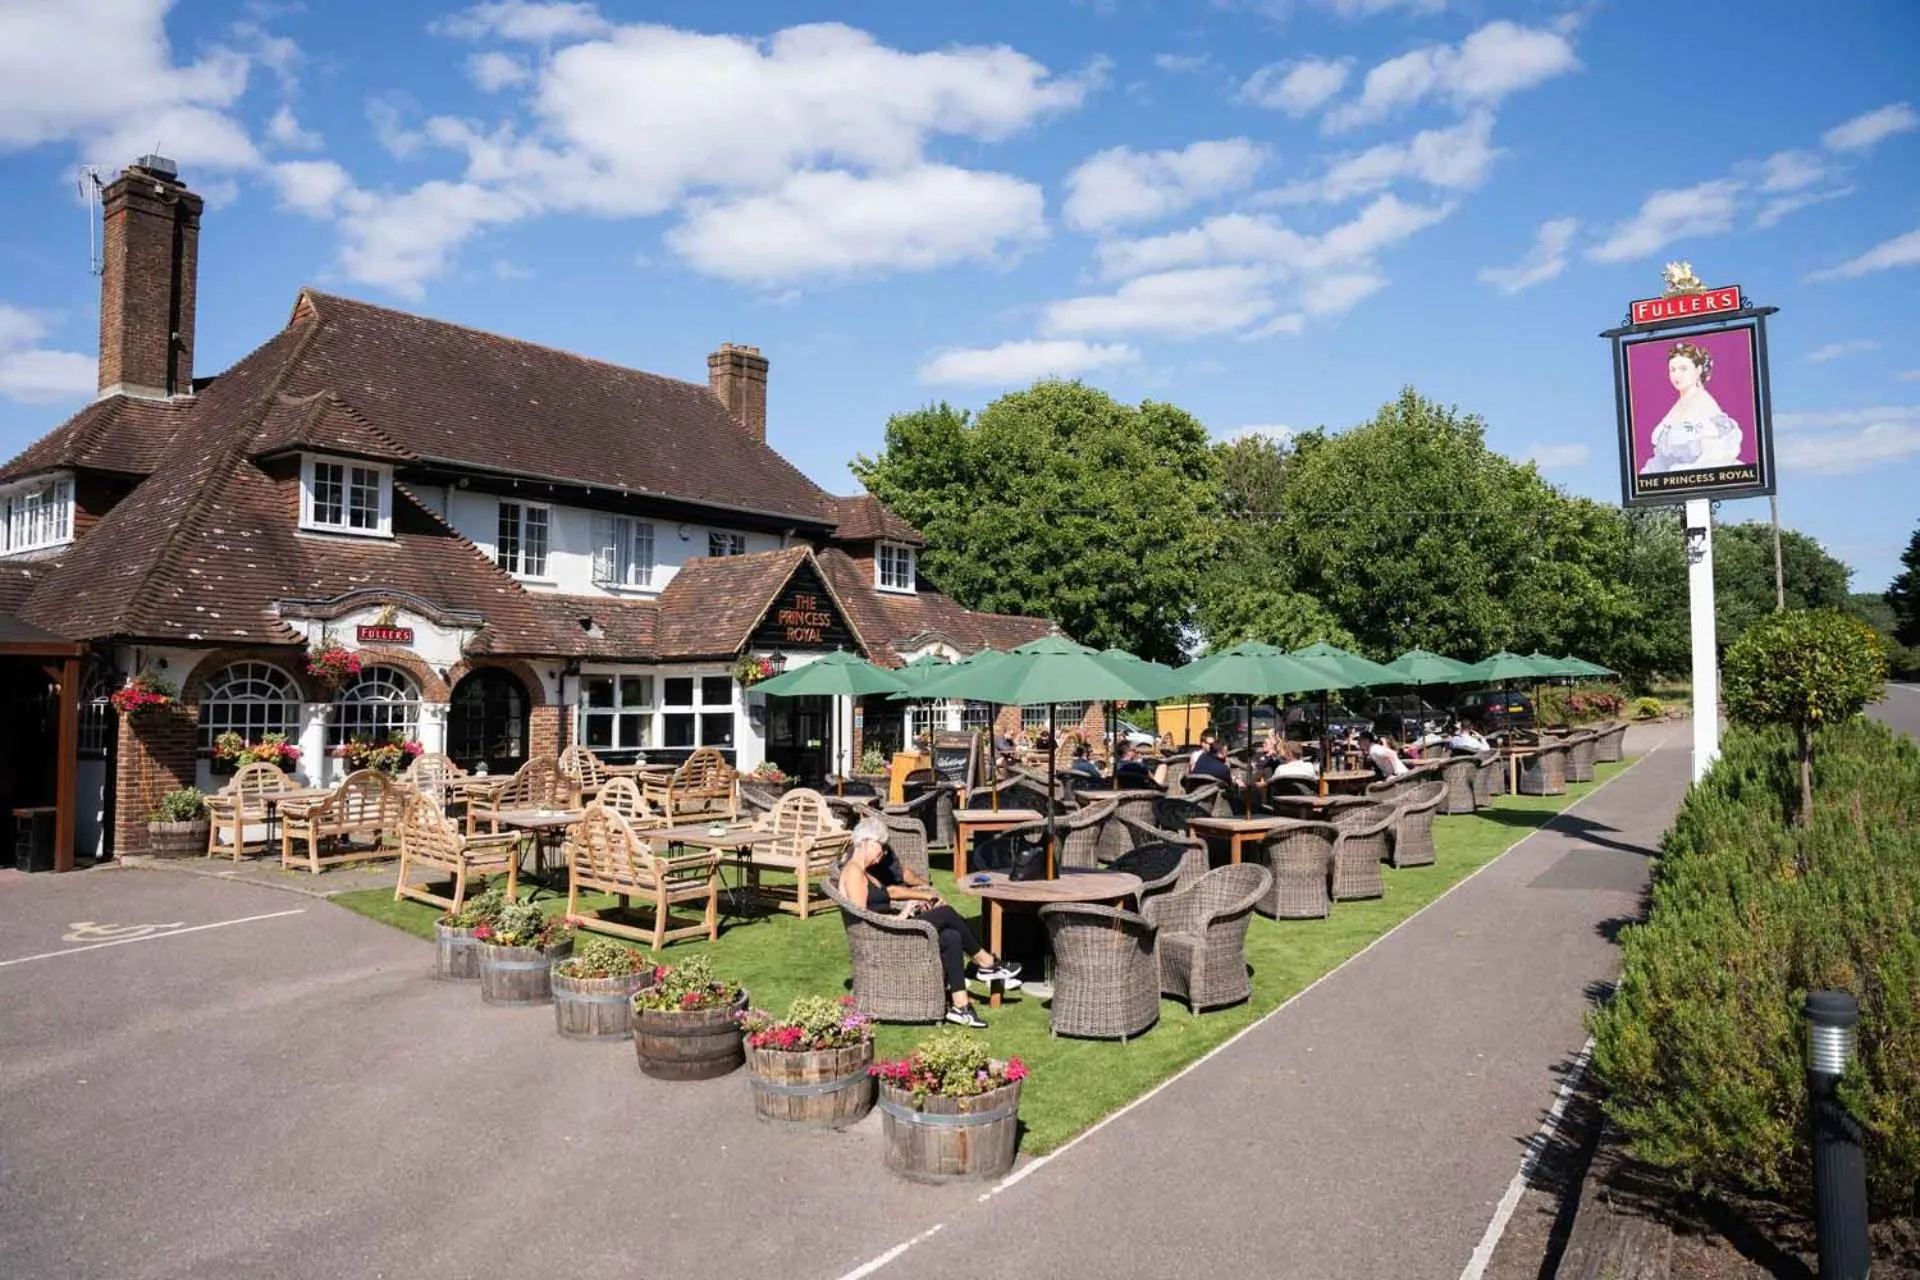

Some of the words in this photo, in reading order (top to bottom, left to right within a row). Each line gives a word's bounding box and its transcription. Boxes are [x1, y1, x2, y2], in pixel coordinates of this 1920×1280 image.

[1639, 293, 1732, 318] FULLER'S
[1640, 478, 1660, 488] THE
[1663, 473, 1715, 486] PRINCESS
[1719, 469, 1755, 481] ROYAL
[795, 594, 817, 610] THE
[778, 609, 831, 627] PRINCESS
[361, 627, 409, 640] FULLER'S
[786, 627, 823, 642] ROYAL
